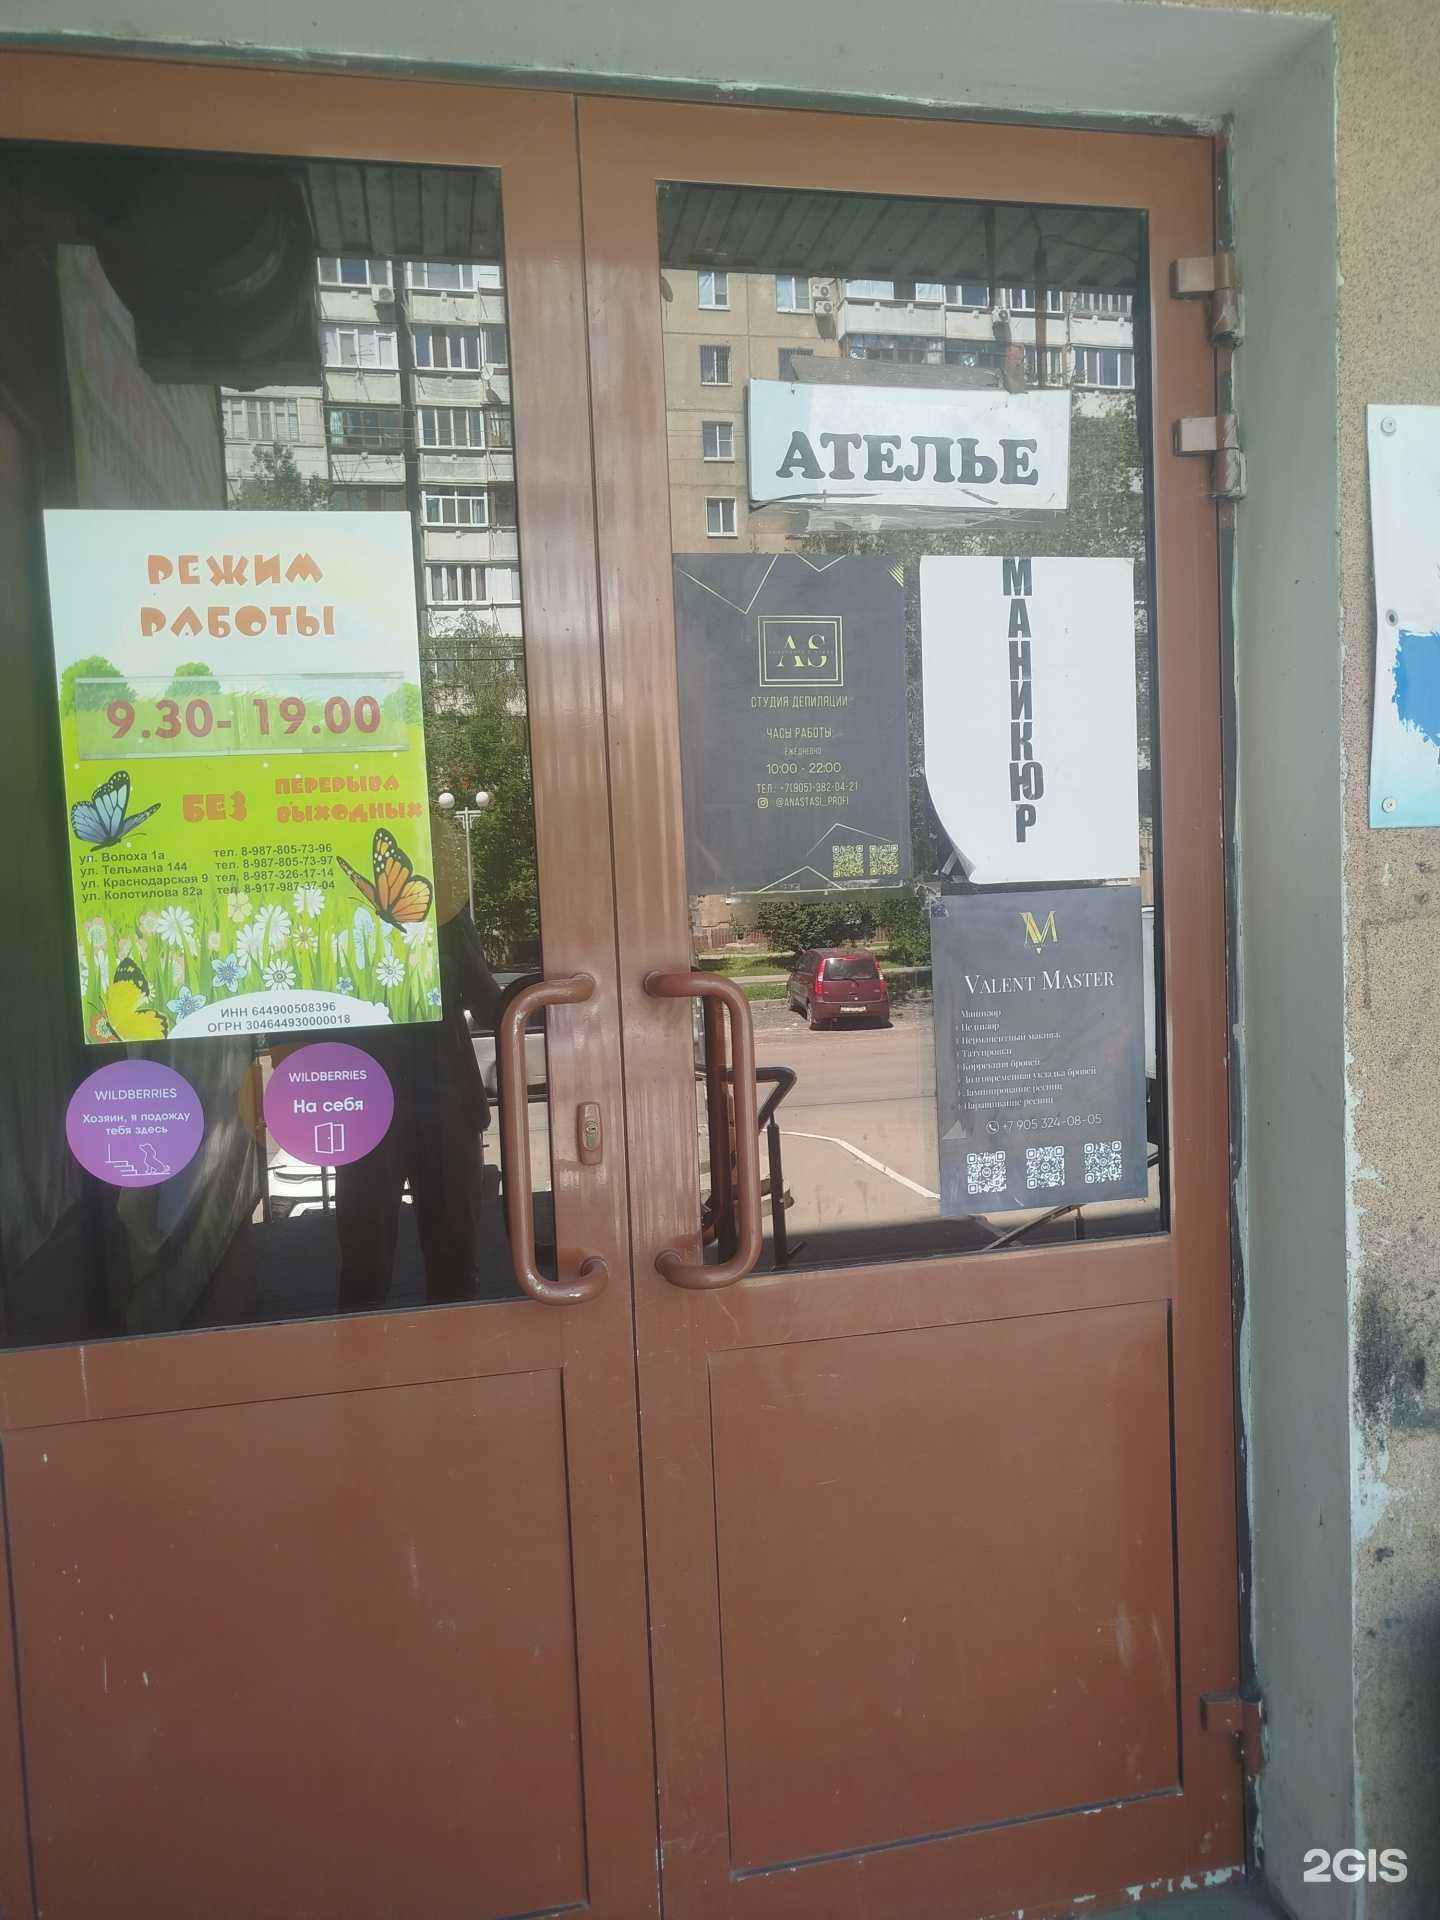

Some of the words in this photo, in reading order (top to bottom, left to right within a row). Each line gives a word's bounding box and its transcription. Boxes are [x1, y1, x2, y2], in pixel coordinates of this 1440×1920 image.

[775, 431, 1039, 486] АТЕЛЬЕ
[147, 553, 324, 586] РЕЖИМ
[140, 605, 336, 638] РАБОТЫ
[776, 634, 828, 668] AS
[751, 696, 789, 708] СТУДИЯ
[792, 695, 848, 708] ДЕПИЛЯЦИИ
[1003, 557, 1044, 843] МАНИКЮР
[253, 696, 381, 735] 19.00
[766, 727, 792, 739] ЧАСЫ
[795, 726, 832, 738] РАБОТЫ
[766, 763, 798, 774] 10:00
[809, 762, 842, 774] 22:00
[275, 775, 400, 795] ПЕРЕРЫВА
[182, 791, 248, 823] БЕЗ
[276, 801, 423, 824] ВЫХОДНЫХ
[79, 854, 98, 865] ул.
[102, 852, 147, 862] Волоха
[152, 850, 165, 860] 1а
[214, 849, 238, 858] тел.
[241, 843, 332, 856] 8-987-805-73-96
[80, 867, 98, 877] ул.
[102, 864, 164, 875] Тельмана
[168, 862, 187, 871] 144
[215, 861, 239, 870] тел.
[242, 855, 333, 869] 8-987-805-73-97
[81, 880, 100, 891] ул.
[103, 876, 198, 889] Краснодарская
[202, 873, 208, 883] 9
[216, 874, 239, 882] тел.
[243, 868, 334, 881] 8-987-326-17-14
[82, 892, 101, 903] ул.
[104, 888, 178, 900] Колотилова
[182, 886, 203, 897] 82а
[221, 1007, 248, 1018] ИНН
[251, 1001, 336, 1017] 644900508396
[208, 1020, 242, 1032] ОГРН
[246, 1014, 351, 1030] 304644930000018
[288, 1070, 367, 1084] WILDBERRIES
[94, 1087, 177, 1101] WILDBERRIES
[293, 1099, 317, 1114] На
[322, 1096, 364, 1112] себя
[83, 1113, 127, 1123] Хозяин,
[131, 1113, 137, 1121] я
[140, 1112, 190, 1122] подожду
[105, 1125, 131, 1135] тебя
[135, 1125, 168, 1135] здесь
